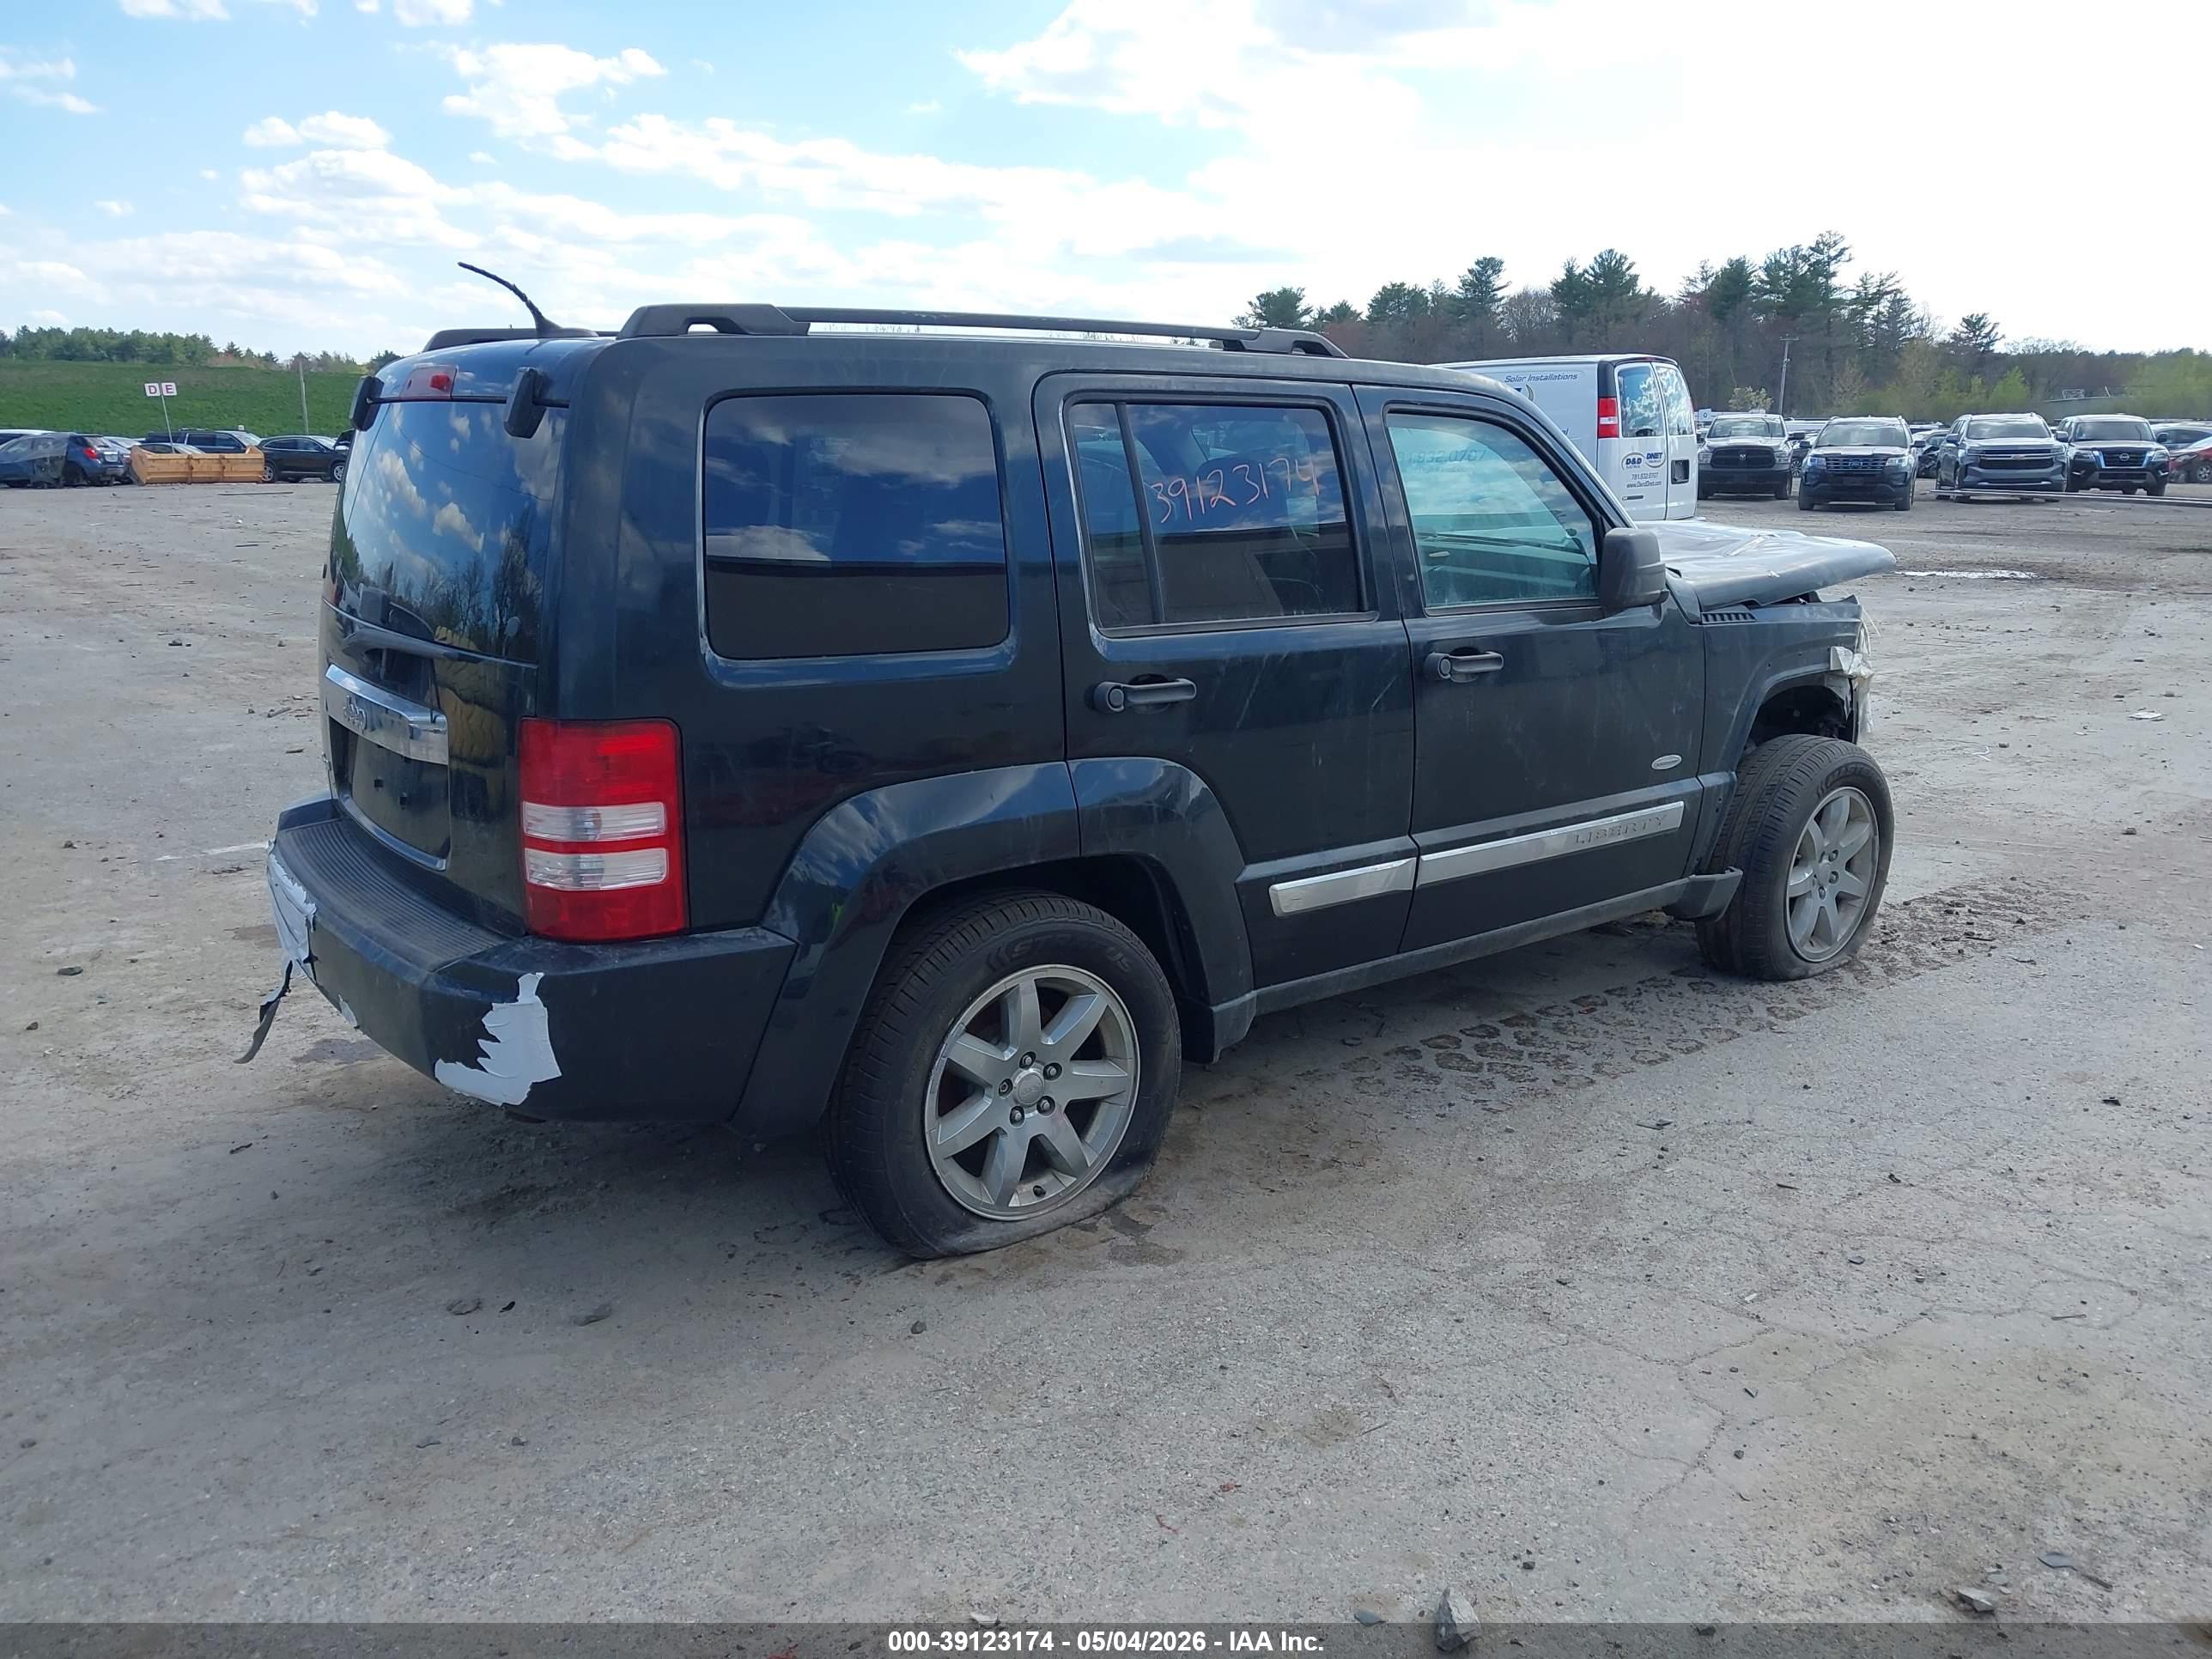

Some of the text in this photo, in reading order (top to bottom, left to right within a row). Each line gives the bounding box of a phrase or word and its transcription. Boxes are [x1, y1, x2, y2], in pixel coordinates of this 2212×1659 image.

[1528, 373, 1578, 382] Installations
[149, 385, 173, 394] D E
[1151, 458, 1320, 524] 39123174
[1572, 815, 1667, 844] LIBERTY
